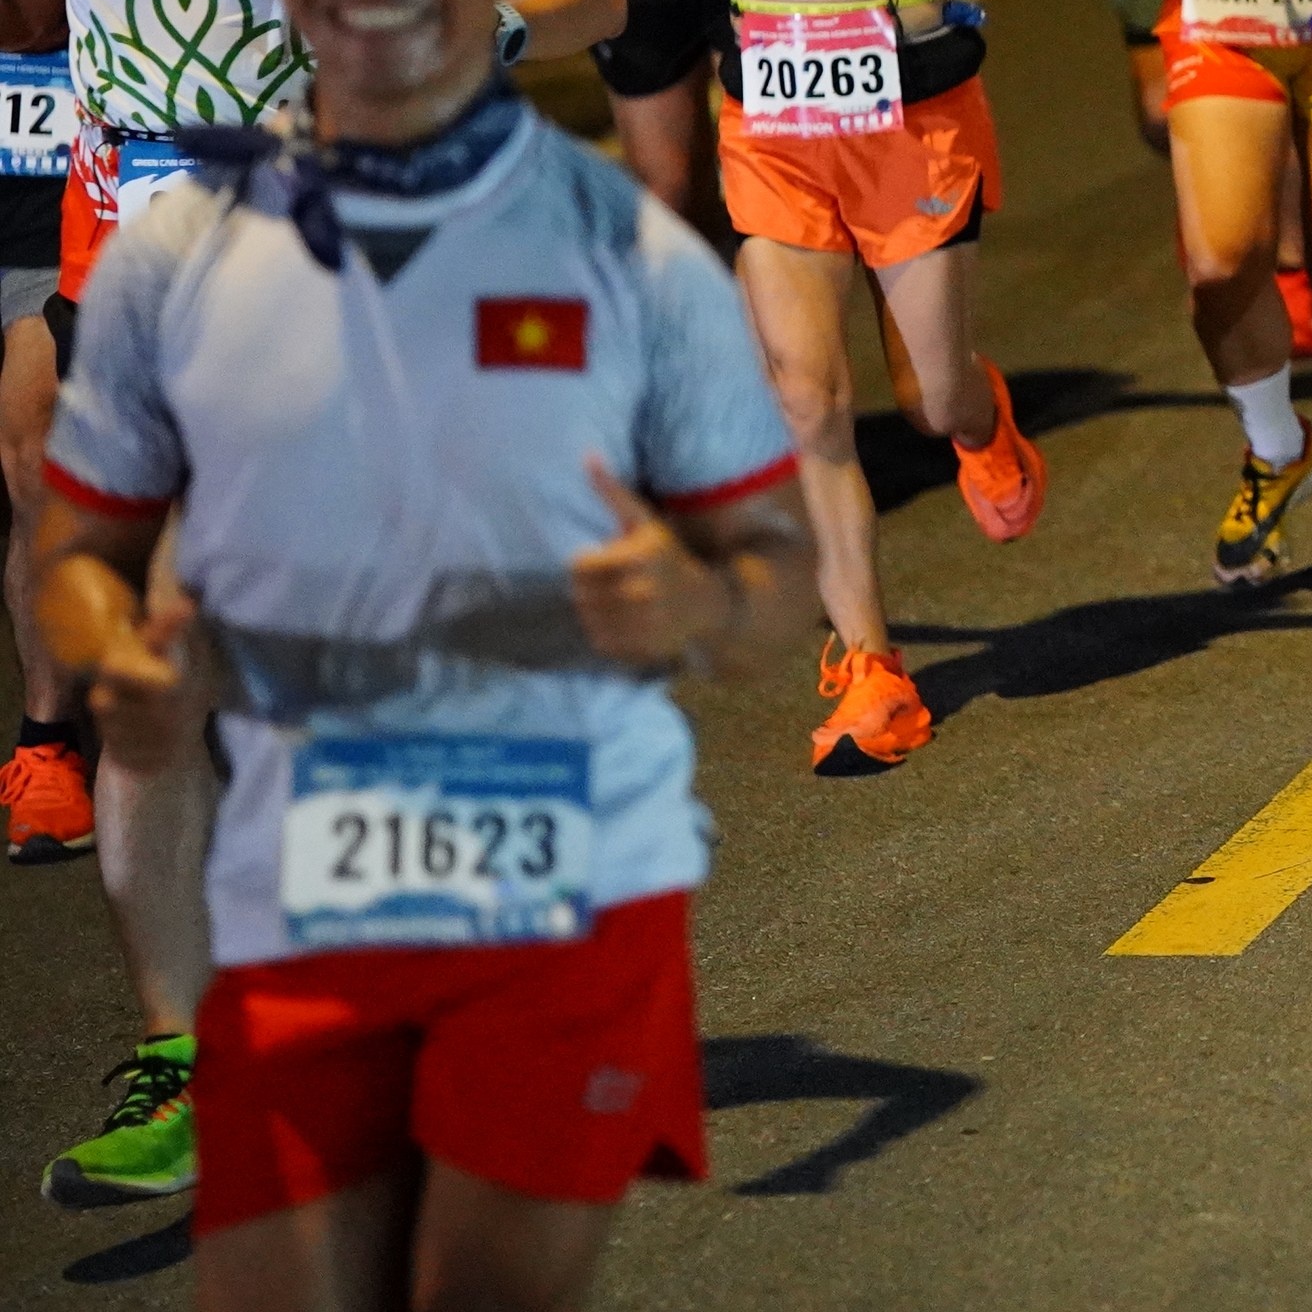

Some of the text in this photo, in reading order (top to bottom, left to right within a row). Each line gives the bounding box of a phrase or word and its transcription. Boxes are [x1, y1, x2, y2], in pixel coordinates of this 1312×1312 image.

[758, 53, 884, 99] 20263
[132, 158, 195, 167] GREEN CAN GIO
[330, 808, 558, 881] 21623
